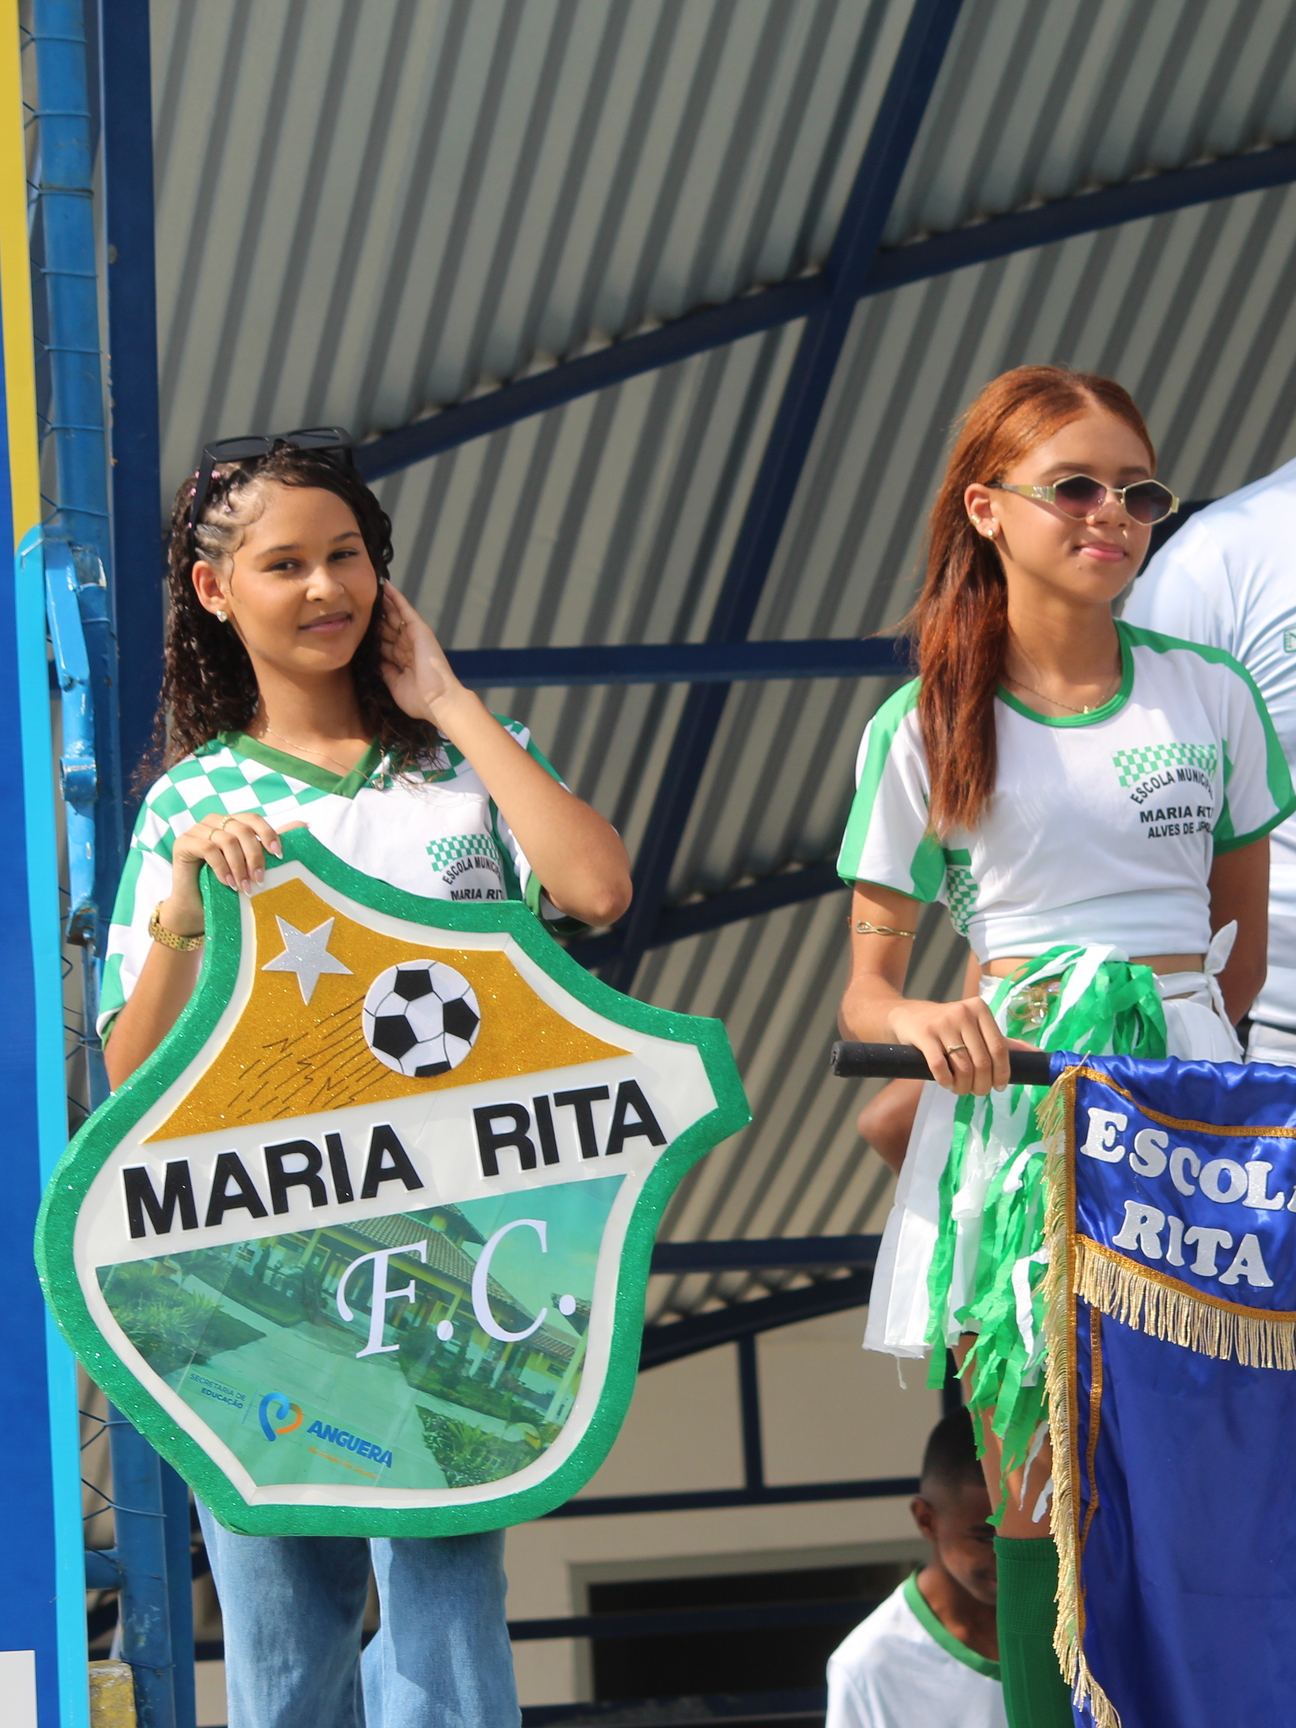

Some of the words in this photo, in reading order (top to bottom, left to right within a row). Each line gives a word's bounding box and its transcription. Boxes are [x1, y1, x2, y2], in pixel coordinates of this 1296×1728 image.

[1129, 770, 1175, 805] ESCOLA
[1139, 805, 1192, 823] MARIA
[1196, 805, 1214, 818] RIT
[1147, 823, 1180, 839] ALVES
[1183, 822, 1194, 835] DE
[442, 857, 473, 885] ESCOLA
[474, 856, 502, 884] MUNIC
[450, 888, 482, 901] MARIA
[486, 888, 503, 900] RIT
[122, 1124, 423, 1239] MARIA
[474, 1079, 668, 1178] RITA
[1112, 1199, 1274, 1288] RITA
[190, 1373, 234, 1397] SECRETARIA
[236, 1392, 247, 1402] DE
[201, 1387, 243, 1409] EDUCAÇÃO
[306, 1420, 393, 1468] ANGUERA
